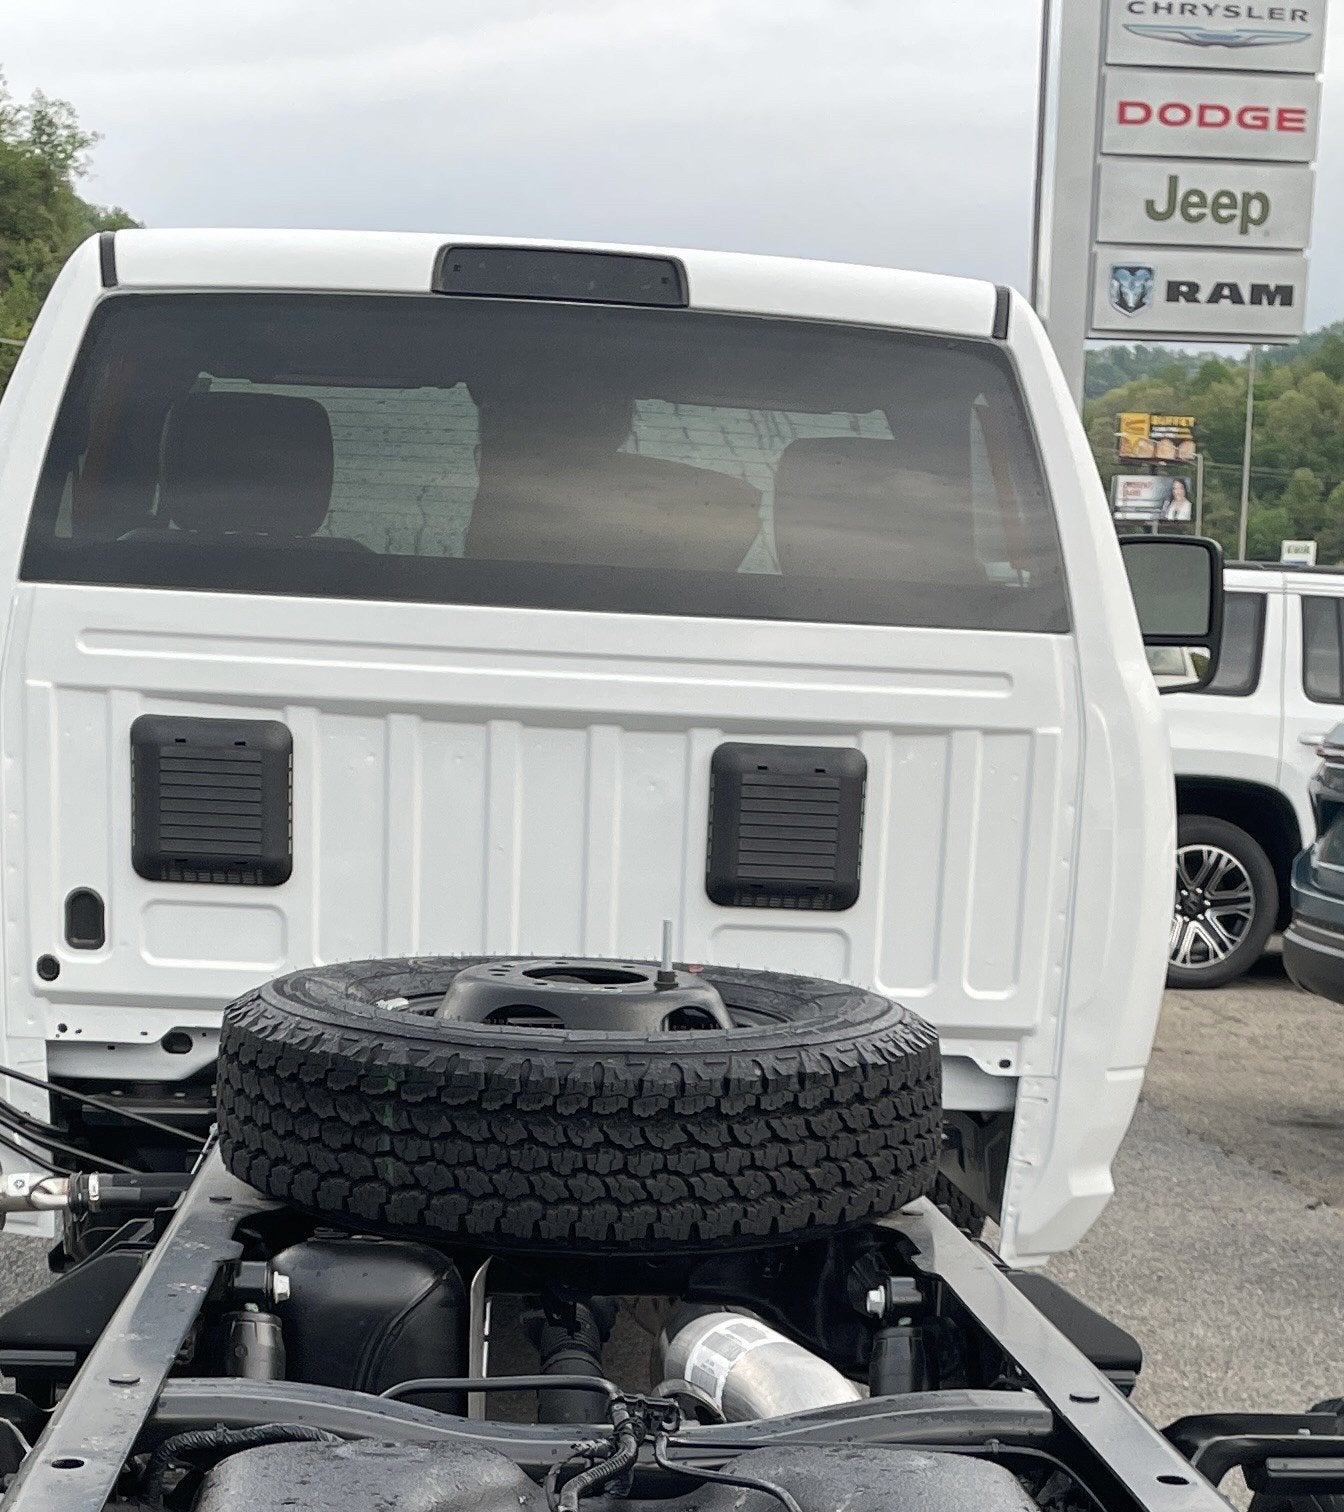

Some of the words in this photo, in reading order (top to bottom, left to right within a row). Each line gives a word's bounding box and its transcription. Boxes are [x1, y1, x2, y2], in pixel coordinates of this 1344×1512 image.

[1127, 0, 1310, 22] CHRYSLER
[1116, 100, 1308, 134] DODGE
[1144, 174, 1271, 236] Jeep
[1165, 279, 1295, 308] RAM
